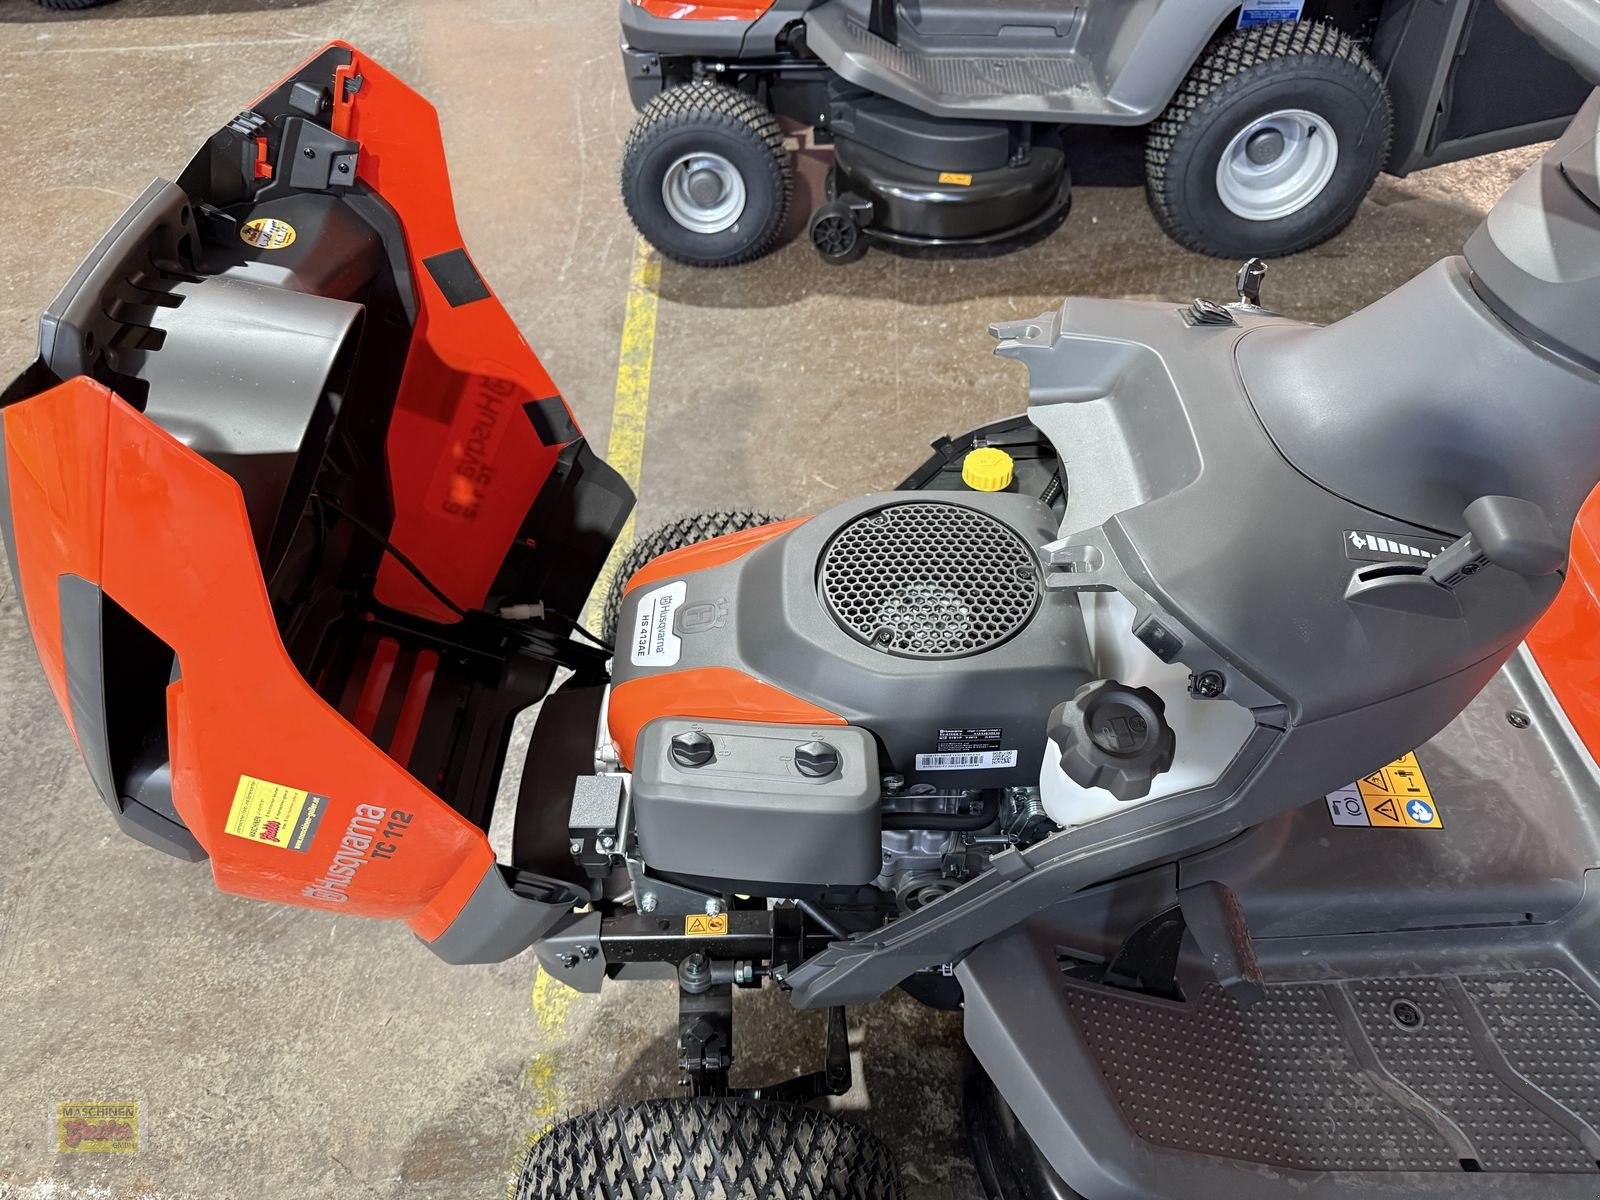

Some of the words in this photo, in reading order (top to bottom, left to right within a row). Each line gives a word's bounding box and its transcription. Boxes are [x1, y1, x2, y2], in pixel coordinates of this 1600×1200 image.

[641, 615, 650, 627] HS
[655, 605, 670, 654] Husqvarna
[637, 631, 648, 657] 413AE
[383, 810, 414, 838] 112
[312, 803, 387, 893] Husqvarna
[370, 841, 397, 860] TC
